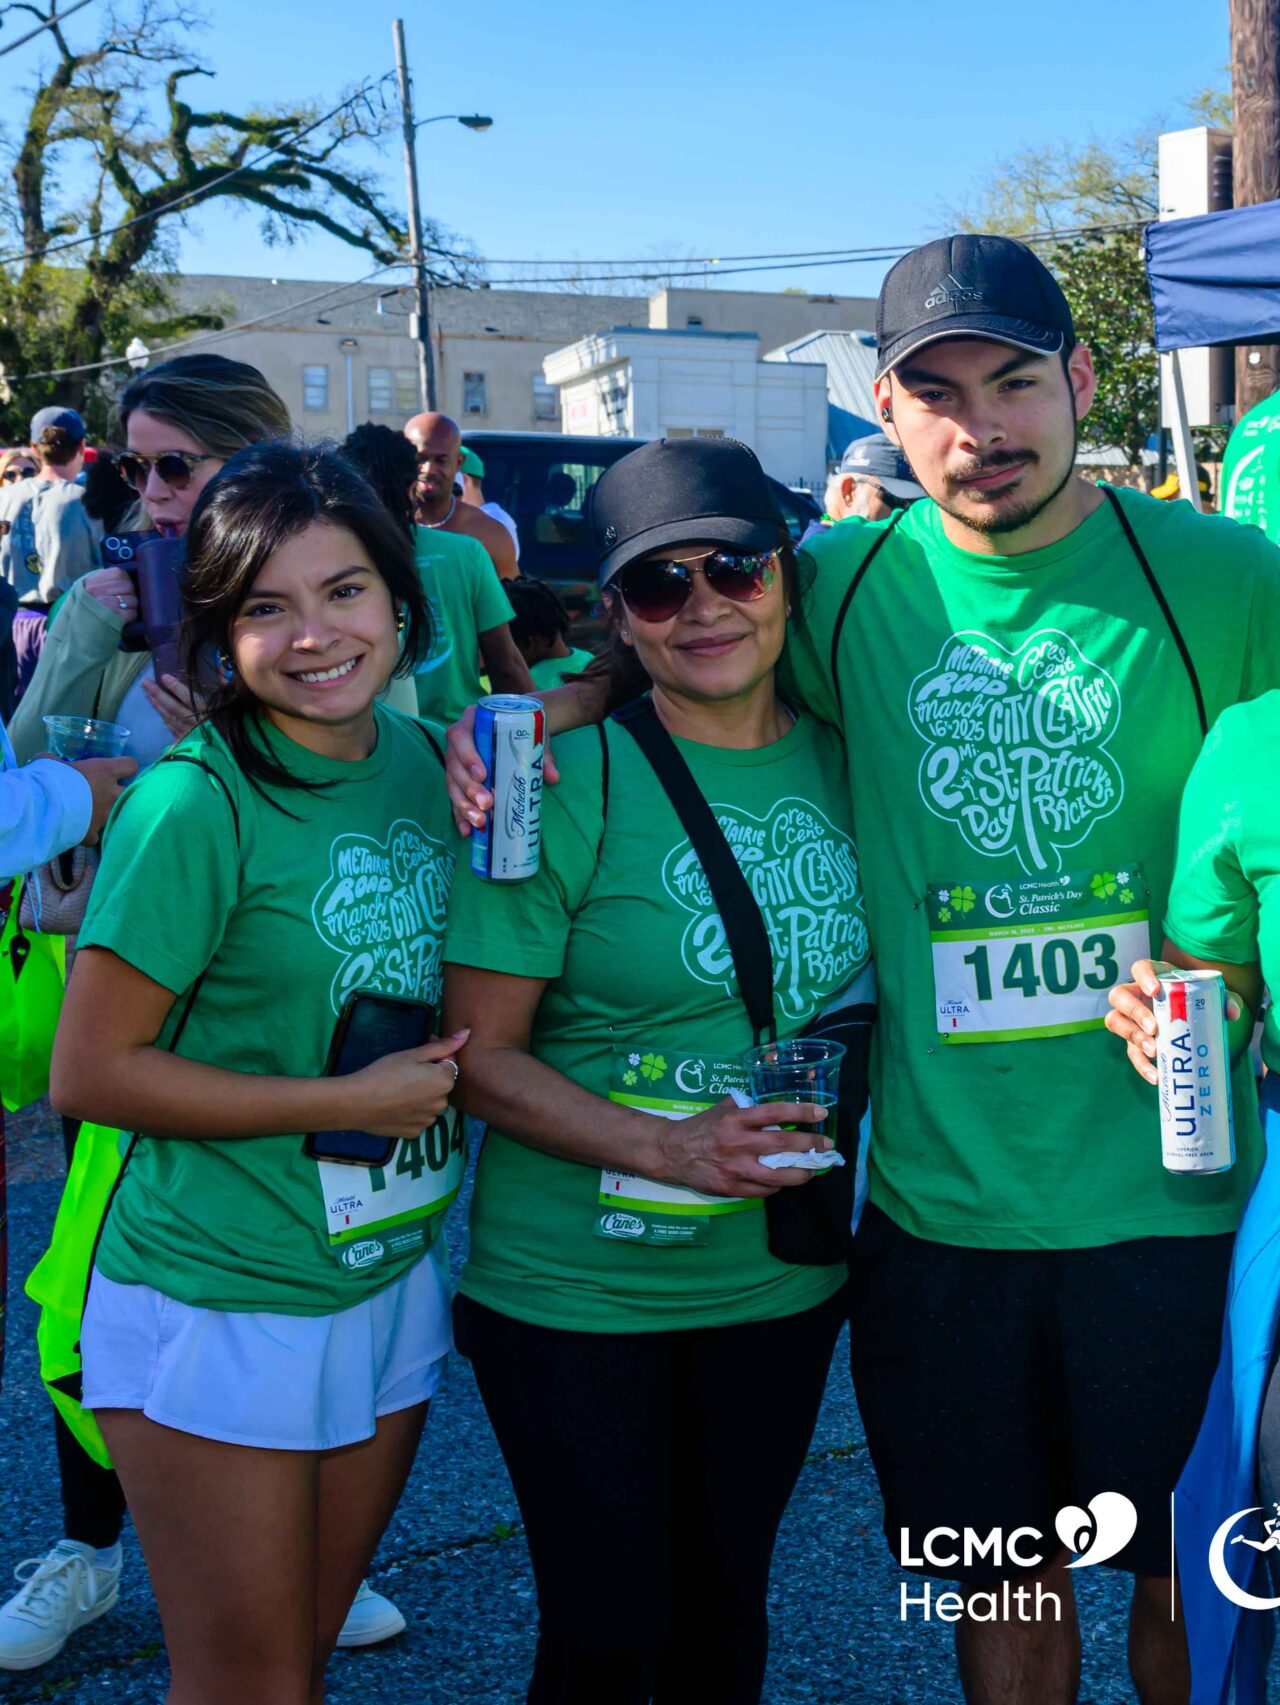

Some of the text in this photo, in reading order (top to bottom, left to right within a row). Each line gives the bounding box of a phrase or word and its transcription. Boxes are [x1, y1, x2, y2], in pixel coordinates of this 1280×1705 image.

[925, 291, 983, 309] adidas
[951, 720, 984, 741] 2025
[928, 746, 964, 809] 2
[511, 775, 527, 838] Michelob
[528, 754, 543, 849] ULTRA
[1033, 795, 1091, 832] RACE
[962, 803, 1015, 849] Day
[1019, 902, 1060, 915] Classic
[1031, 892, 1065, 902] Patrick's
[1066, 890, 1083, 899] Day
[963, 933, 1120, 1001] 1403
[940, 1005, 970, 1014] ULTRA
[1197, 1044, 1212, 1117] ZERO
[330, 1200, 363, 1213] ULTRA
